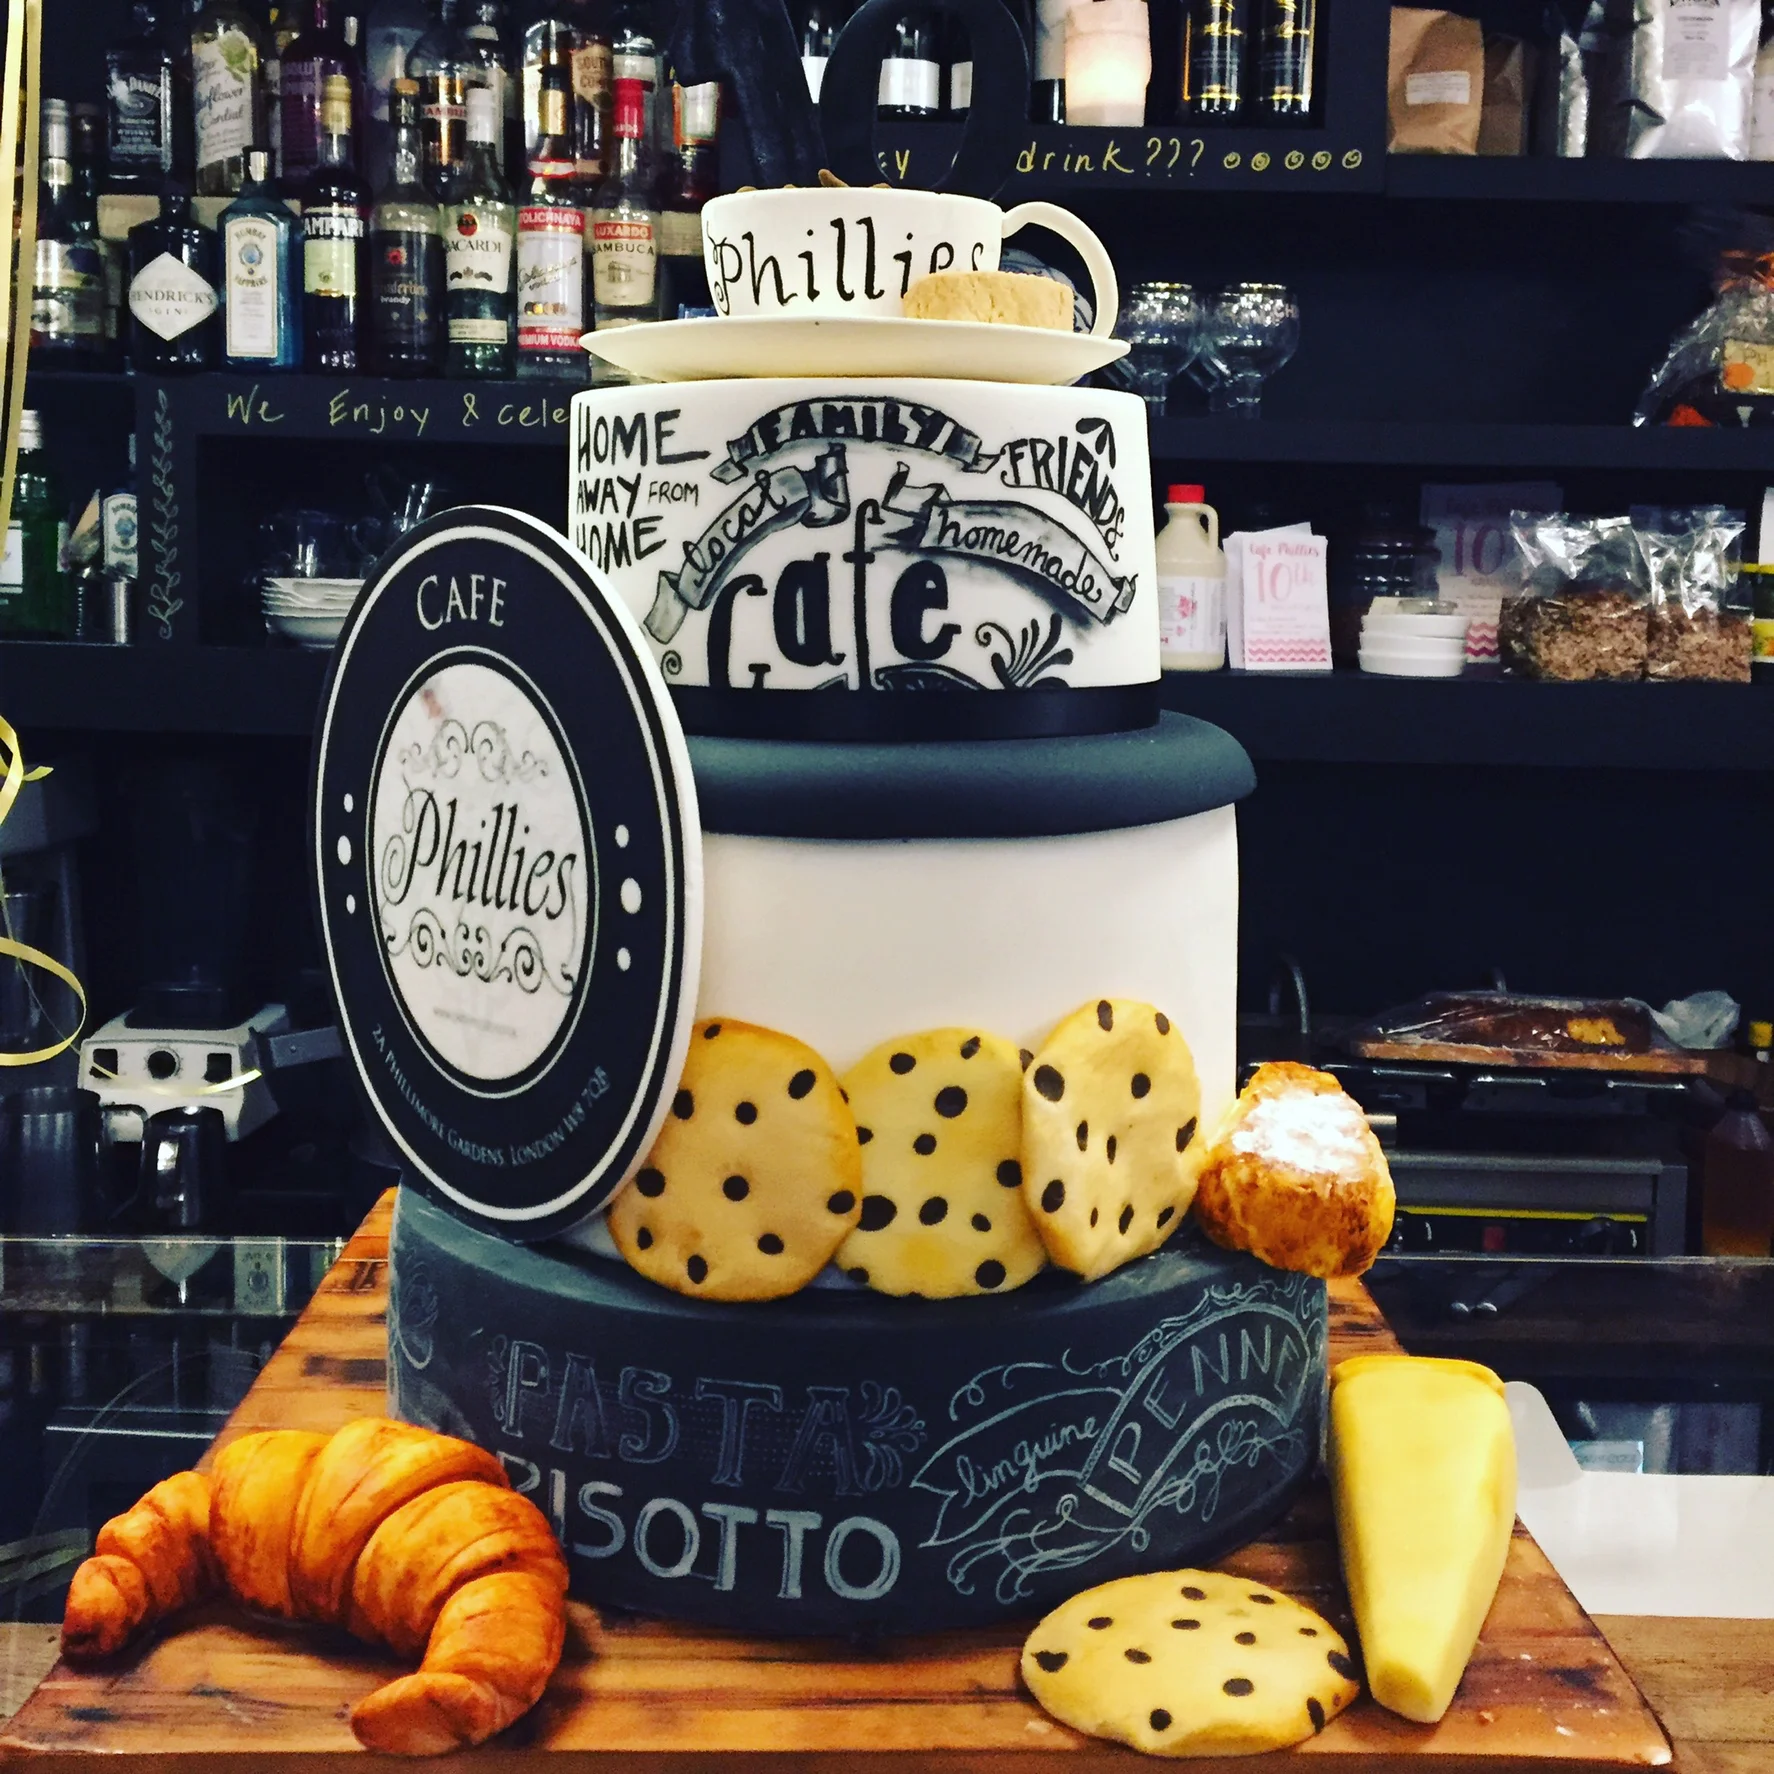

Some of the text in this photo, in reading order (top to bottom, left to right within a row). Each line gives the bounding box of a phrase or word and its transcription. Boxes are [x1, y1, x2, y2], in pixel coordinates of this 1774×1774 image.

[303, 216, 364, 238] AMPARI
[227, 385, 285, 425] We
[329, 389, 429, 437] Enjoy
[577, 402, 712, 474] HOME
[576, 473, 700, 519] AWAY FROM
[1006, 435, 1126, 564] FRIENDS
[936, 508, 1103, 604] homemade
[417, 574, 507, 630] CAFE
[381, 776, 578, 920] Phillies
[501, 1340, 866, 1496] PASTA
[957, 1415, 1101, 1510] linguine
